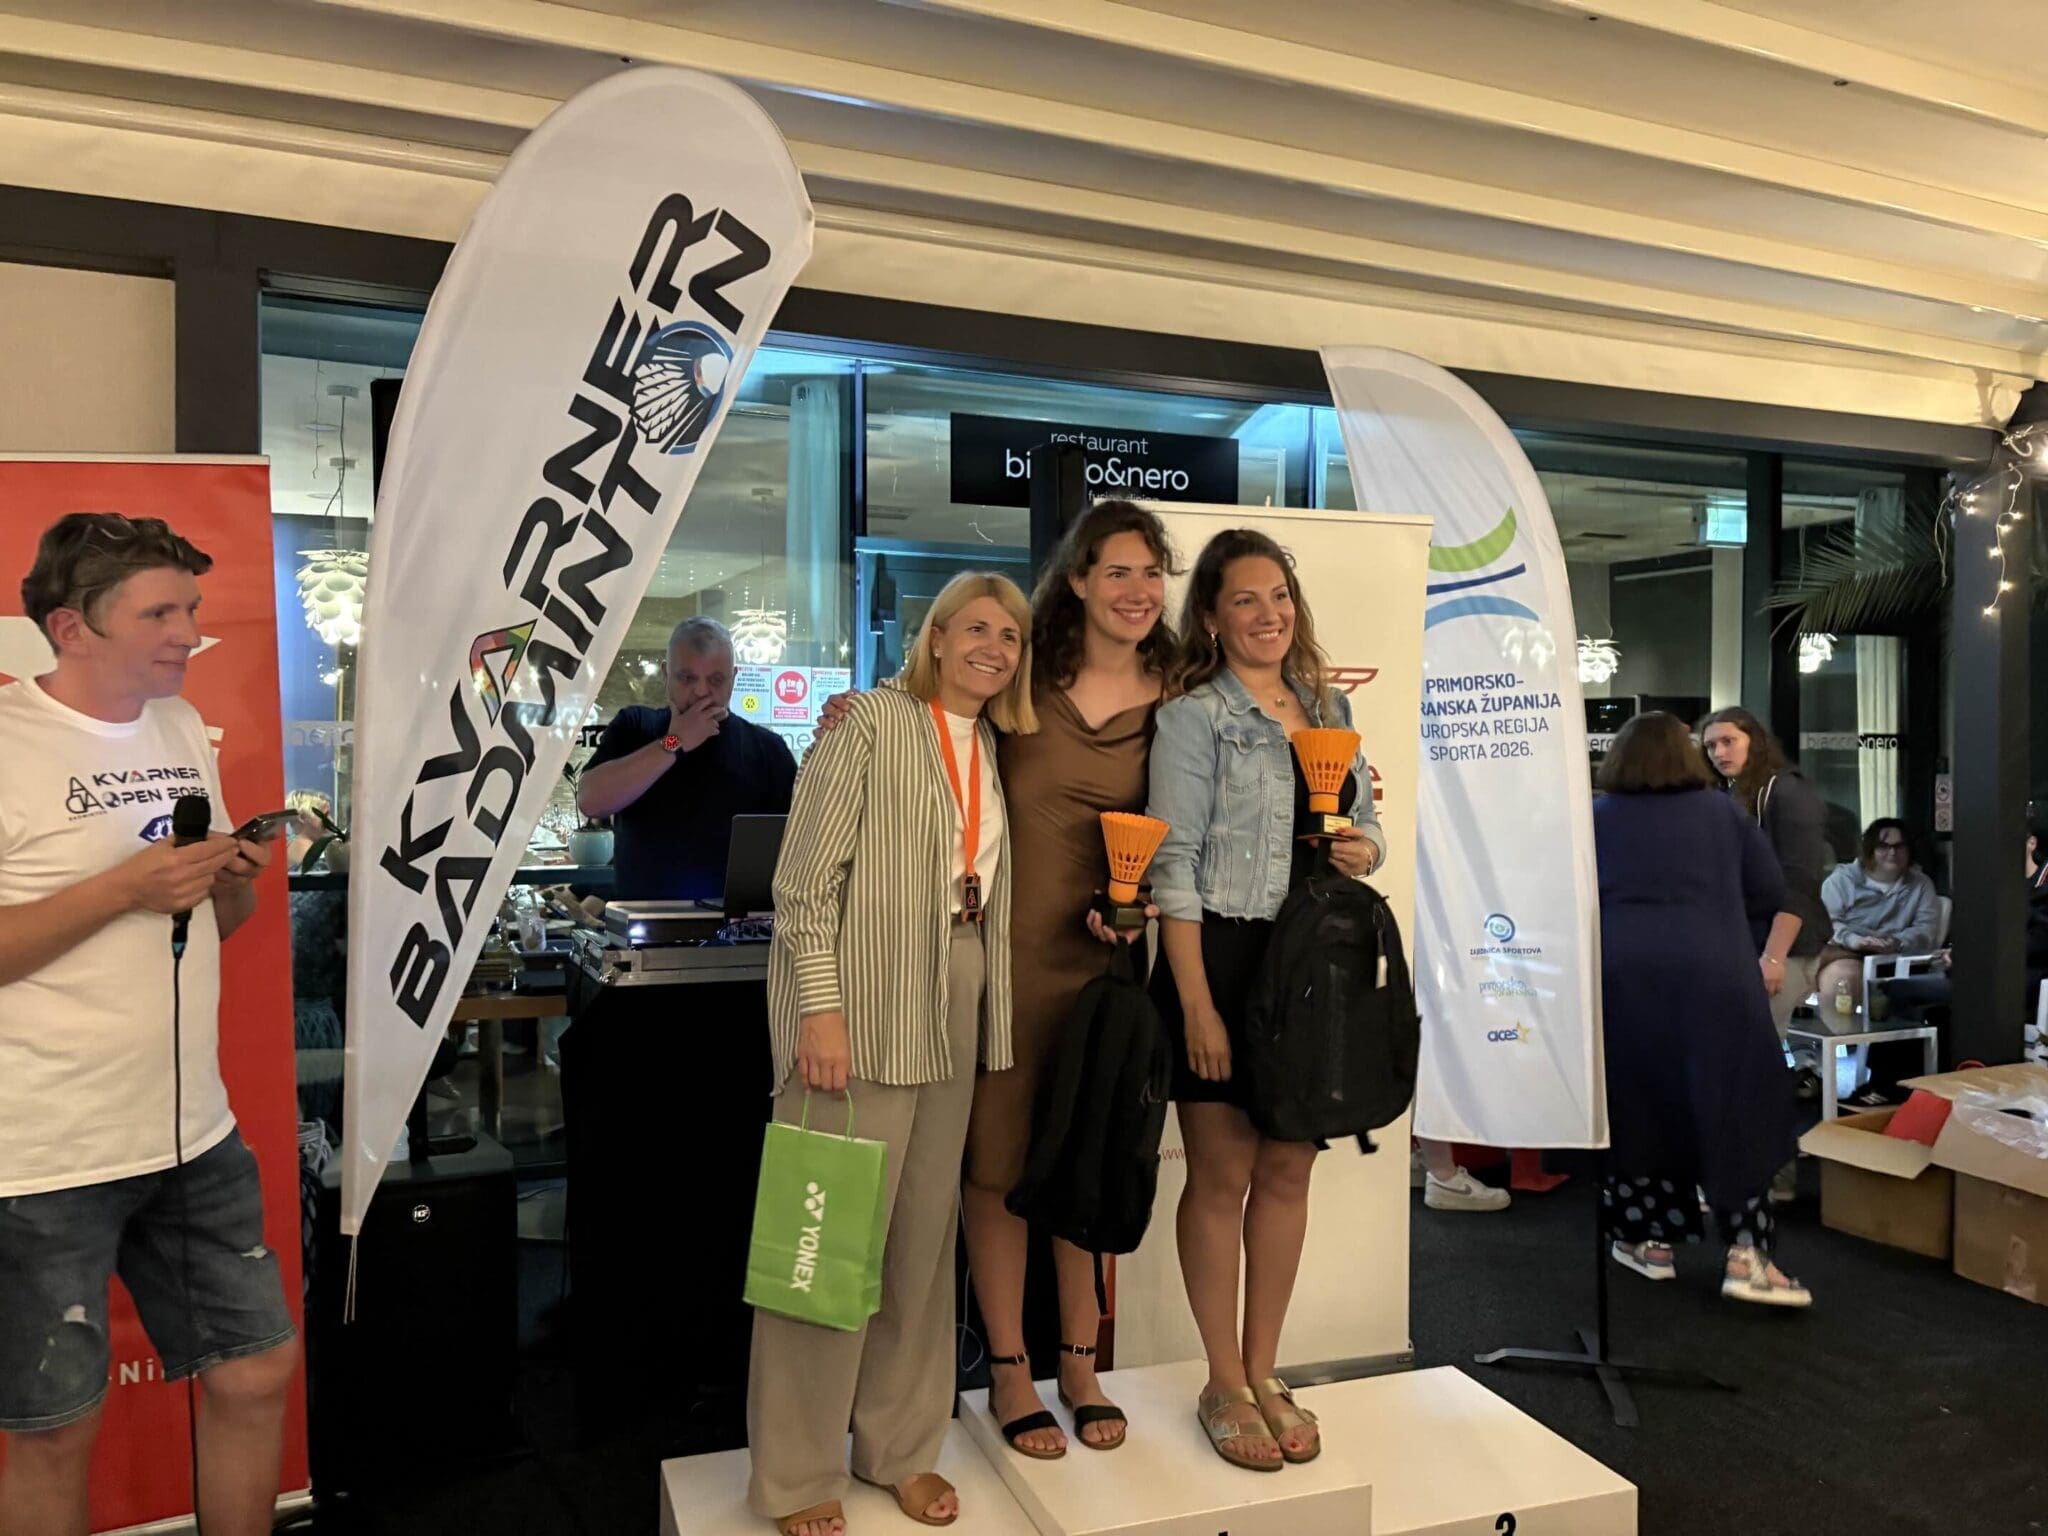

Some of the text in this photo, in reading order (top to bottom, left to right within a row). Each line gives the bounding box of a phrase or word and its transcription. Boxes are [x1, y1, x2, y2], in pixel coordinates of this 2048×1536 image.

[1005, 448, 1190, 491] bio&nero
[380, 192, 720, 895] KVARNER
[389, 208, 771, 1029] BADMINTON
[1481, 693, 1562, 713] ŽUPANIJA
[1494, 717, 1550, 735] REGIJA
[1429, 741, 1534, 762] SPORTA 2026.
[92, 767, 202, 787] KVARNER
[102, 787, 163, 809] OPEN
[789, 1225, 822, 1293] YONEX
